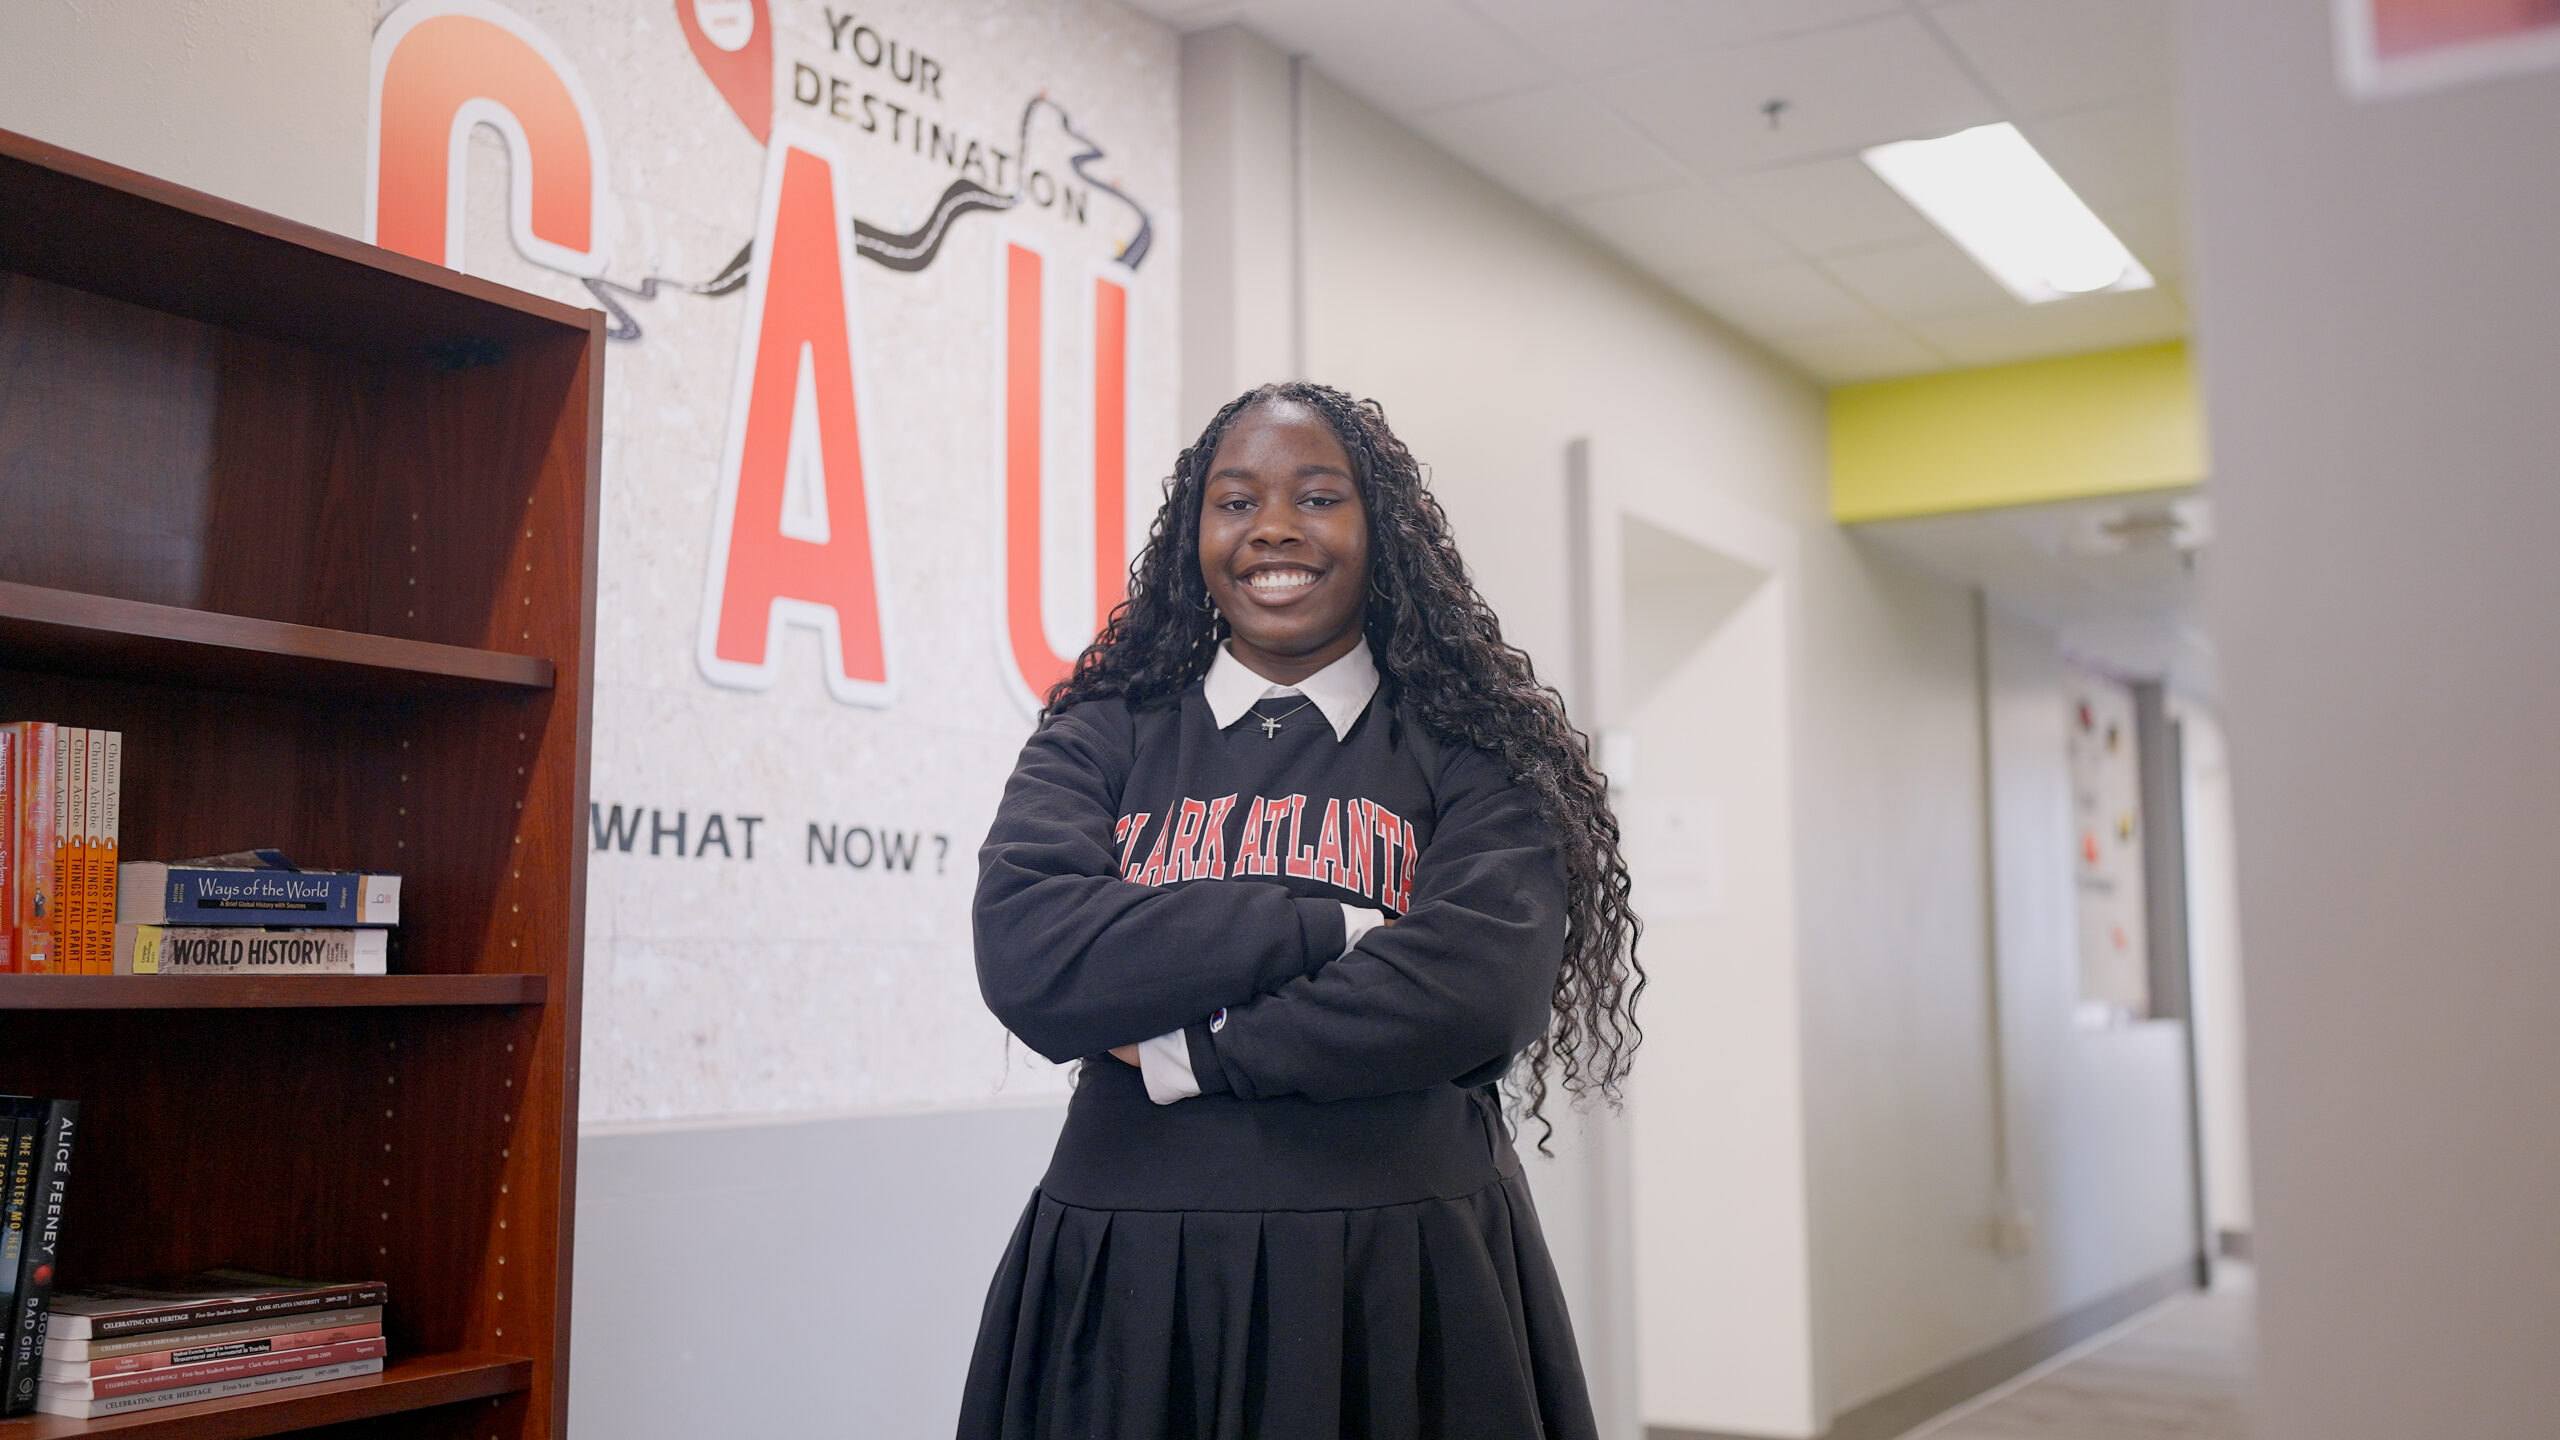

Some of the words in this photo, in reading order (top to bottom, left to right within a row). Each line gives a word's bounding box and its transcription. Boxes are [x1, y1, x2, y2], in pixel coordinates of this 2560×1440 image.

[824, 8, 941, 99] YOUR
[794, 62, 1089, 225] DESTINATON
[56, 739, 67, 782] Chinua
[74, 739, 84, 781] Chinua
[91, 741, 102, 783] Chinua
[107, 743, 118, 785] Chinua
[55, 786, 65, 829] Achebe
[72, 785, 83, 828] Achebe
[89, 787, 100, 829] Achebe
[105, 788, 116, 830] Achebe
[591, 803, 764, 860] WHAT
[1232, 793, 1418, 916] ATLANTA
[71, 858, 82, 896] THINGS
[87, 859, 99, 897] THINGS
[103, 860, 114, 898] THINGS
[198, 878, 240, 901] Ways
[243, 879, 260, 896] of
[262, 880, 284, 896] the
[286, 880, 330, 899] World
[70, 900, 81, 925] FALL
[86, 901, 98, 925] FALL
[102, 902, 113, 926] FALL
[69, 929, 80, 962] APART
[85, 929, 97, 962] APART
[100, 930, 112, 963] APART
[173, 939, 244, 965] WORLD
[247, 939, 326, 965] HISTORY
[19, 1135, 33, 1156] THE
[55, 1117, 73, 1172] ALICE
[12, 1162, 29, 1205] FOSTER
[6, 1211, 22, 1259] MOTHER
[42, 1180, 64, 1255] FEENEY
[24, 1297, 39, 1330] BAD
[103, 1319, 145, 1330] CELEBRATING
[145, 1316, 160, 1325] OUR
[160, 1313, 189, 1323] HERITAGE
[17, 1335, 33, 1371] GIRL
[34, 1312, 48, 1356] GOOD
[101, 1341, 140, 1352] CELEBRATING
[140, 1339, 153, 1347] OUR
[105, 1379, 140, 1389] CELEBRATING
[140, 1376, 153, 1384] OUR
[105, 1396, 155, 1409] CELEBRATING
[158, 1393, 174, 1402] OUR
[176, 1387, 212, 1399] HERITAGE
[254, 1378, 278, 1387] Student
[280, 1373, 304, 1383] Seminar
